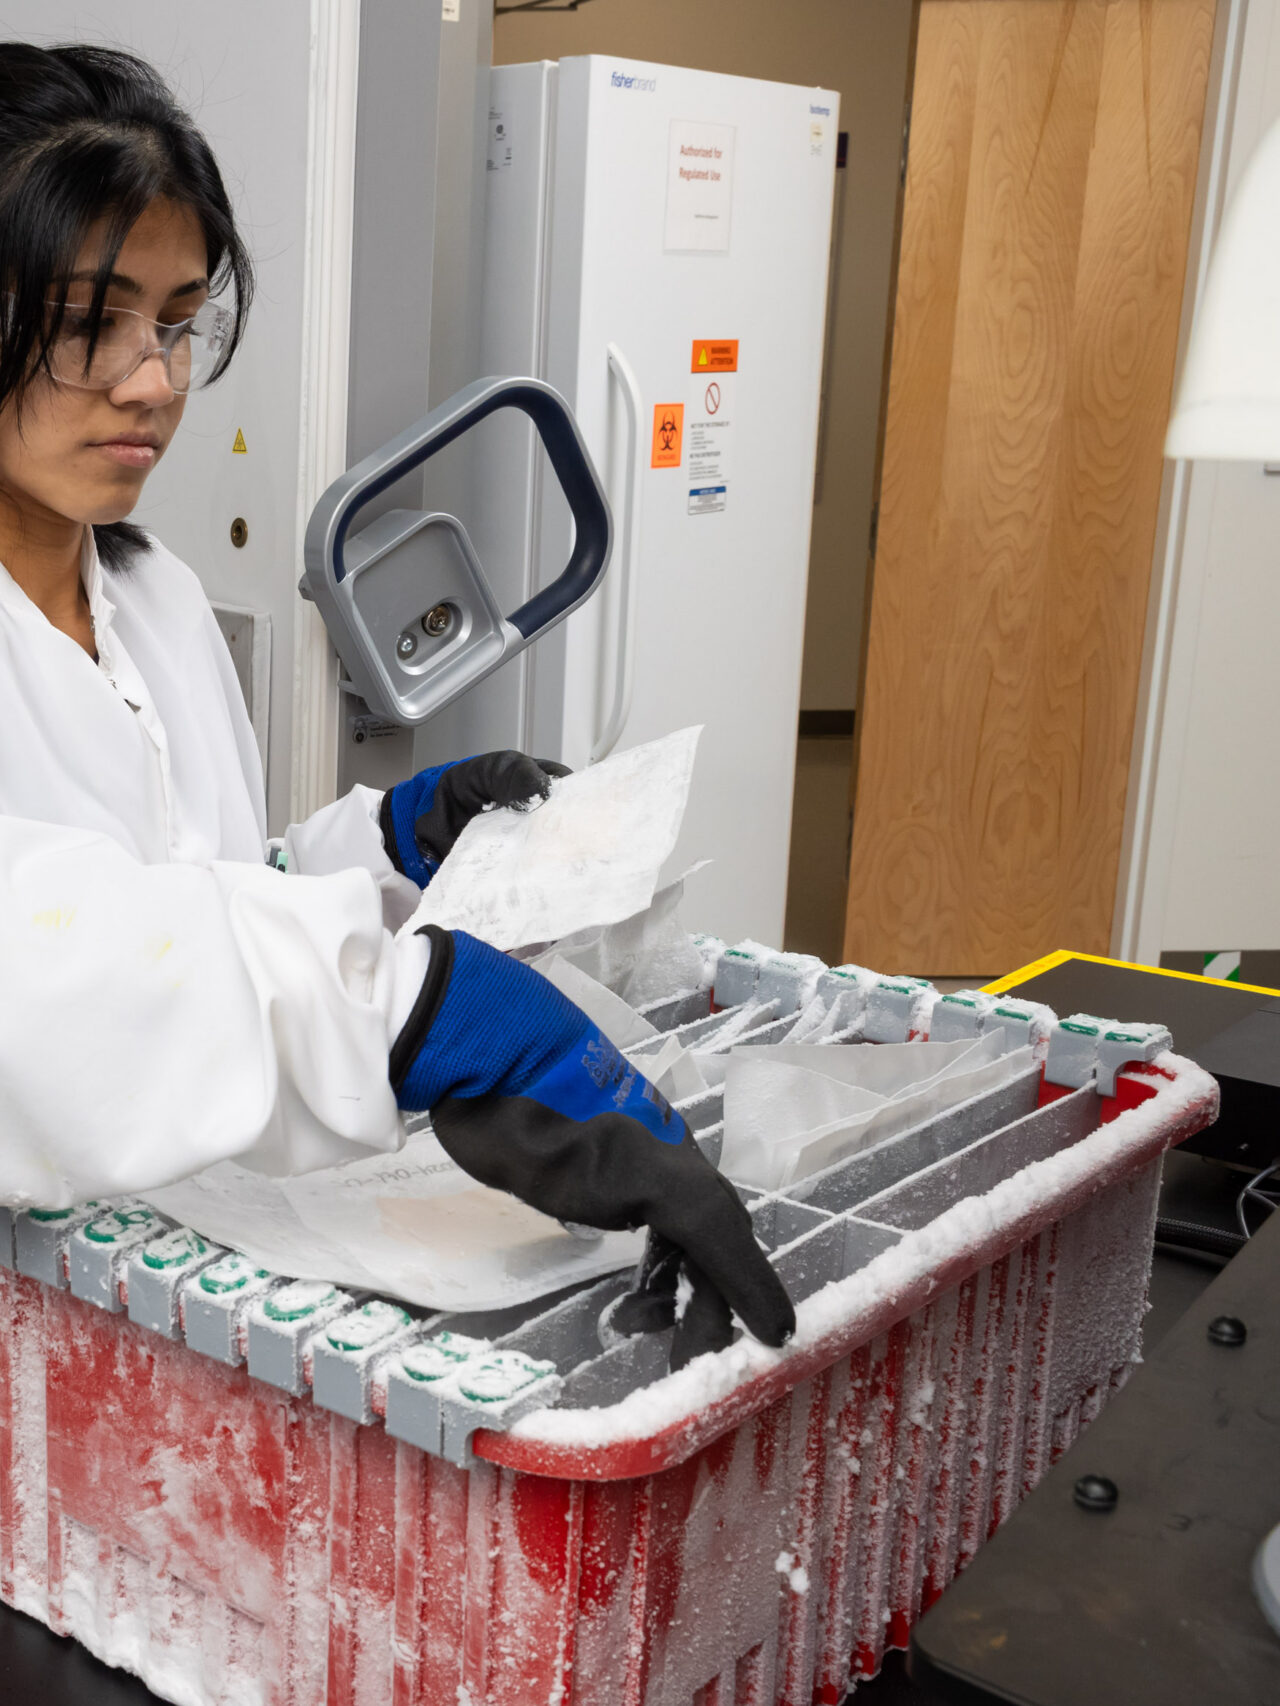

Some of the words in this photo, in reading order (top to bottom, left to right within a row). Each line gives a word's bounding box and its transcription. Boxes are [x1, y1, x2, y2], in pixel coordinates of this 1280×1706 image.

[610, 71, 657, 92] fisherbrand
[680, 144, 713, 159] Authorized
[713, 146, 723, 159] for
[678, 166, 709, 181] Regulated
[709, 170, 721, 181] Use
